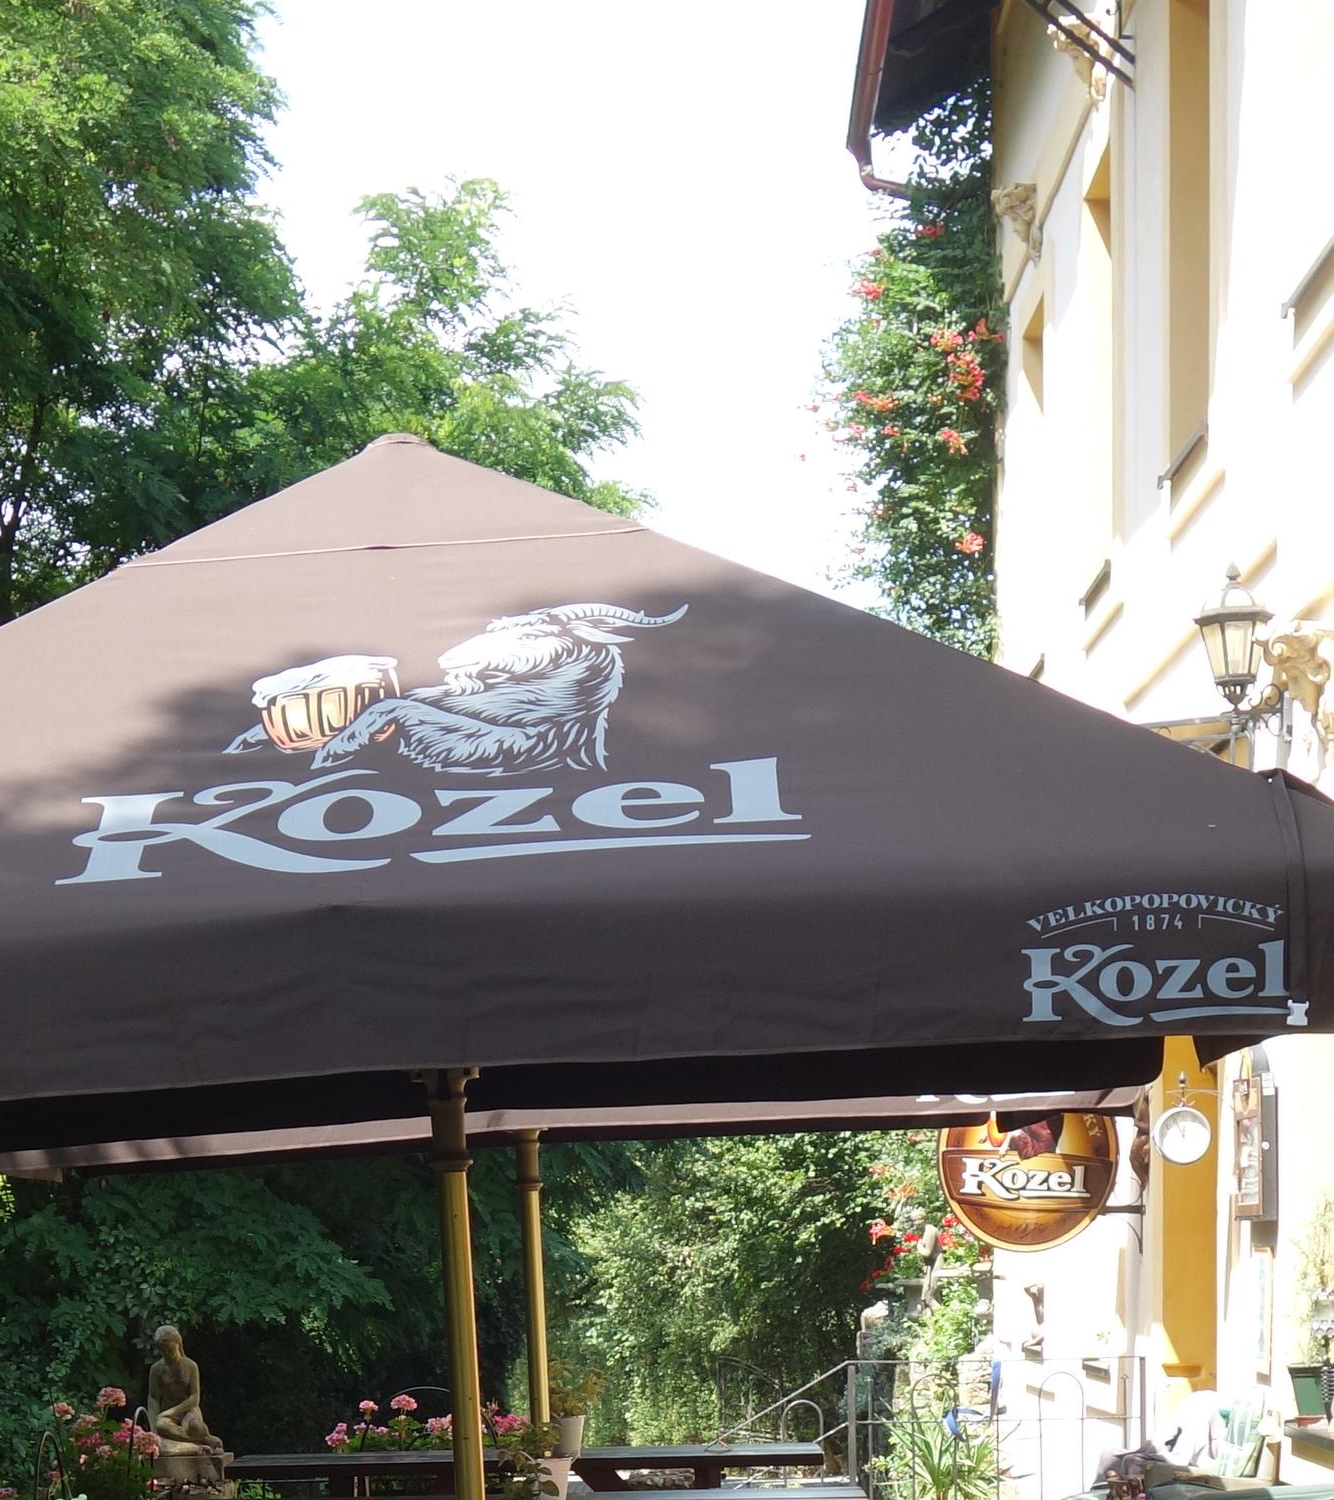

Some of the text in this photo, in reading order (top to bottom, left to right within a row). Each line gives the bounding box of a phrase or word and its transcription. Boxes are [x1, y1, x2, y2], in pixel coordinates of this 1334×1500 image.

[55, 754, 811, 886] Kozel
[1026, 893, 1285, 933] VELKOPOPOVICKÝ
[1132, 914, 1185, 931] 1874
[1021, 939, 1291, 1026] Kozel
[959, 1156, 1090, 1201] Kozel
